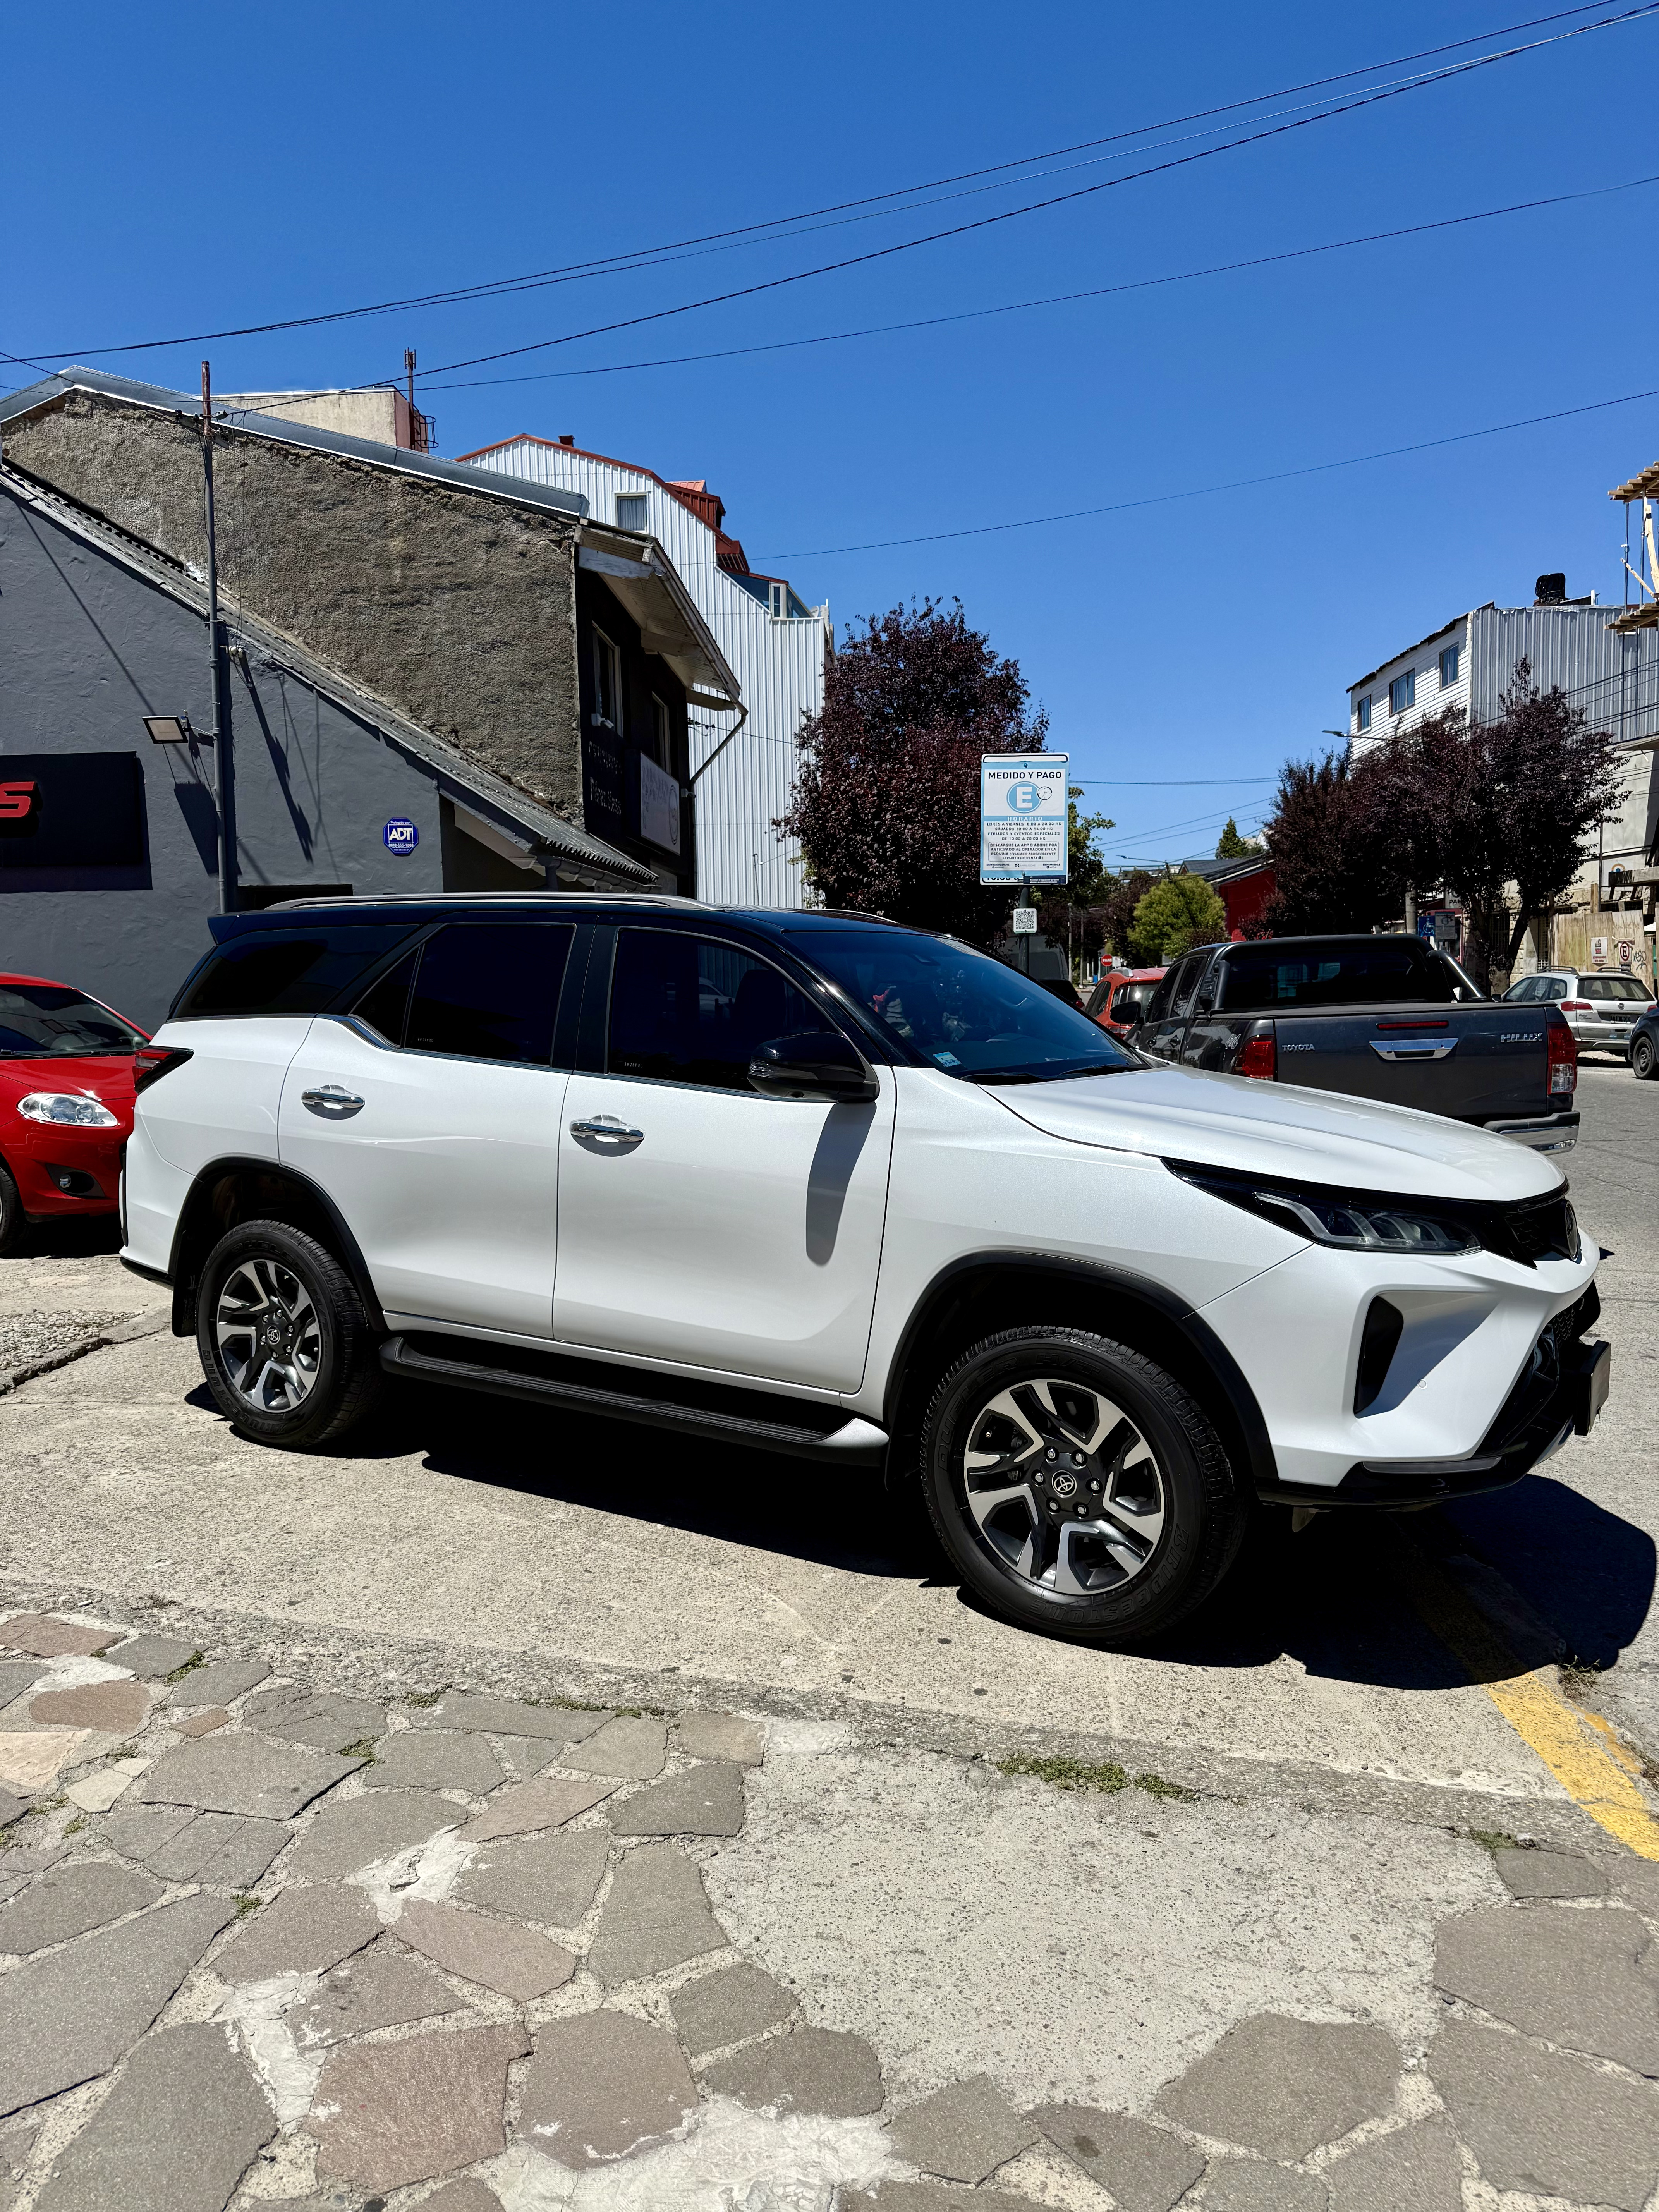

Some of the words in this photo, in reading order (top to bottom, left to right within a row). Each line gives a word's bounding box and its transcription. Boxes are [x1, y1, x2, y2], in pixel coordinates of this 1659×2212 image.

[1017, 787, 1032, 808] E
[389, 828, 412, 840] ADT
[1501, 1032, 1543, 1042] HILUX
[202, 1350, 286, 1434] BRIDGESTONE
[937, 1357, 1018, 1473] DUELER
[1029, 1523, 1189, 1624] BRIDGESTONE
